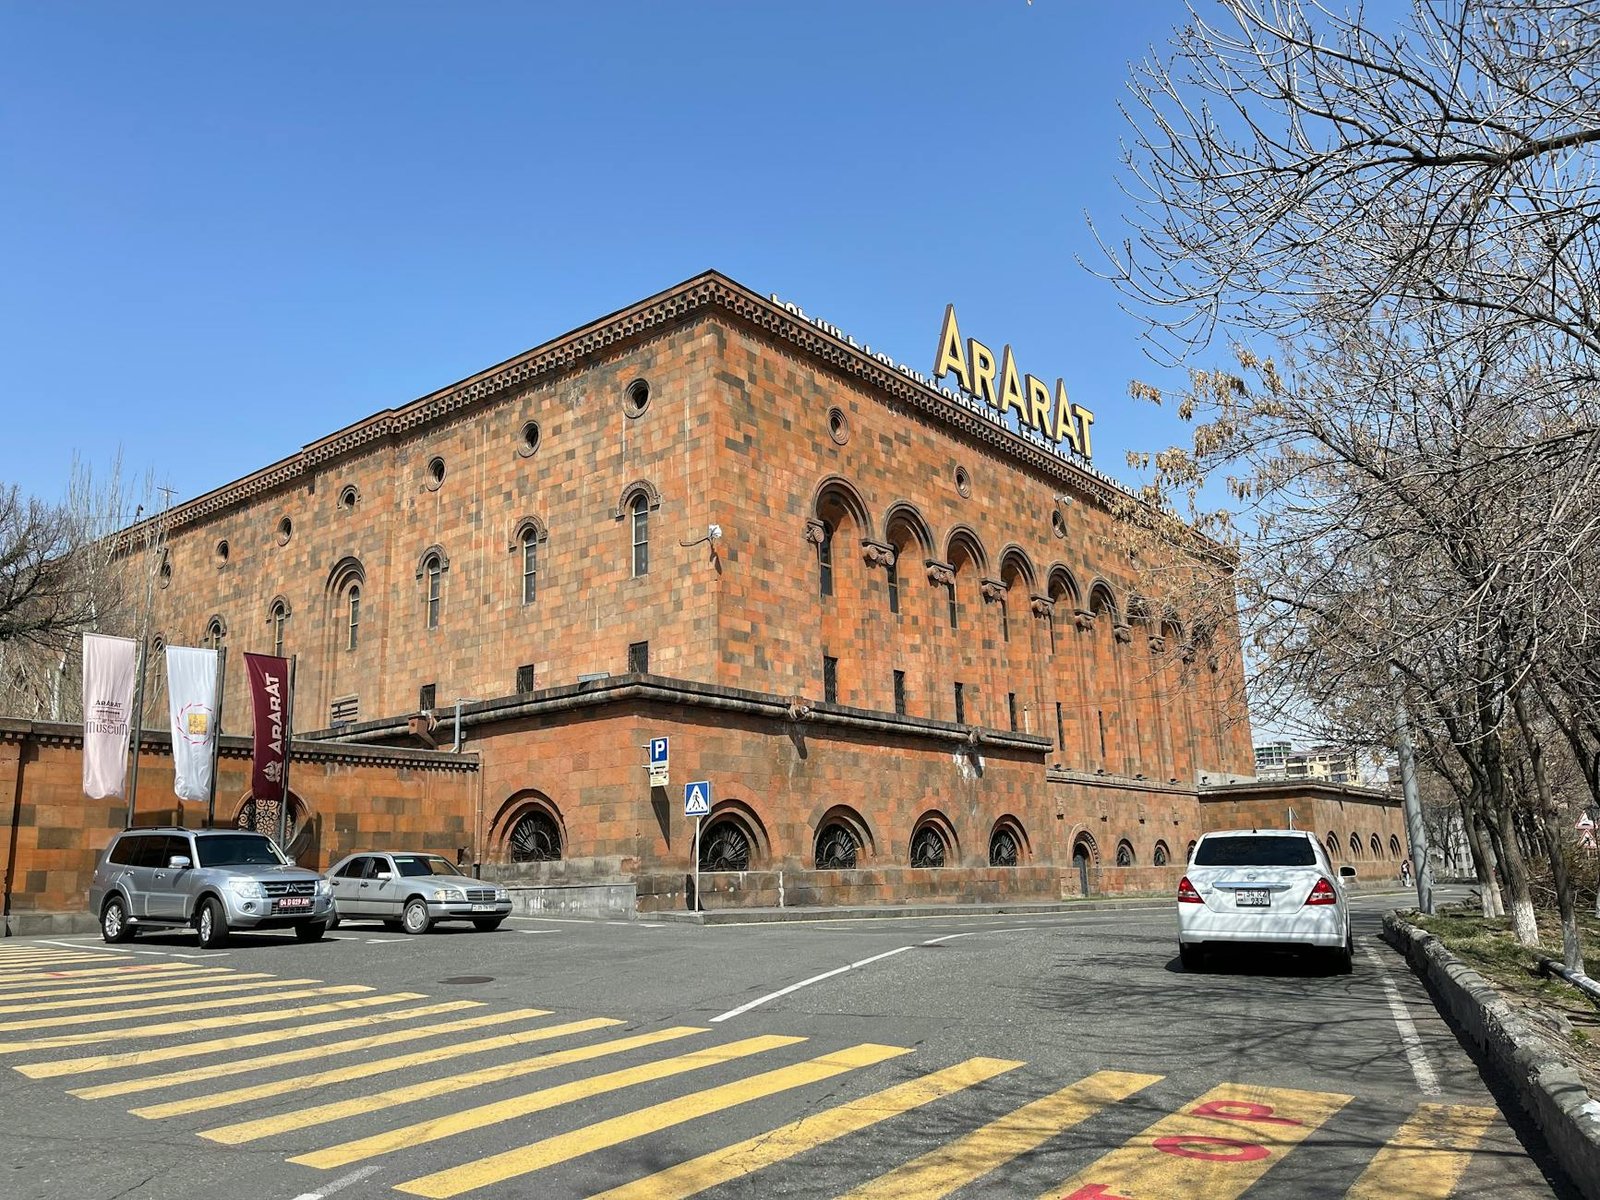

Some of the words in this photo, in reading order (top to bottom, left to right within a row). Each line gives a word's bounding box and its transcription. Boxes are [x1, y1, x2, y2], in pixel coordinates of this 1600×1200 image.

[934, 303, 1094, 459] ARARAT
[265, 672, 282, 755] ARARAT
[655, 741, 665, 759] P
